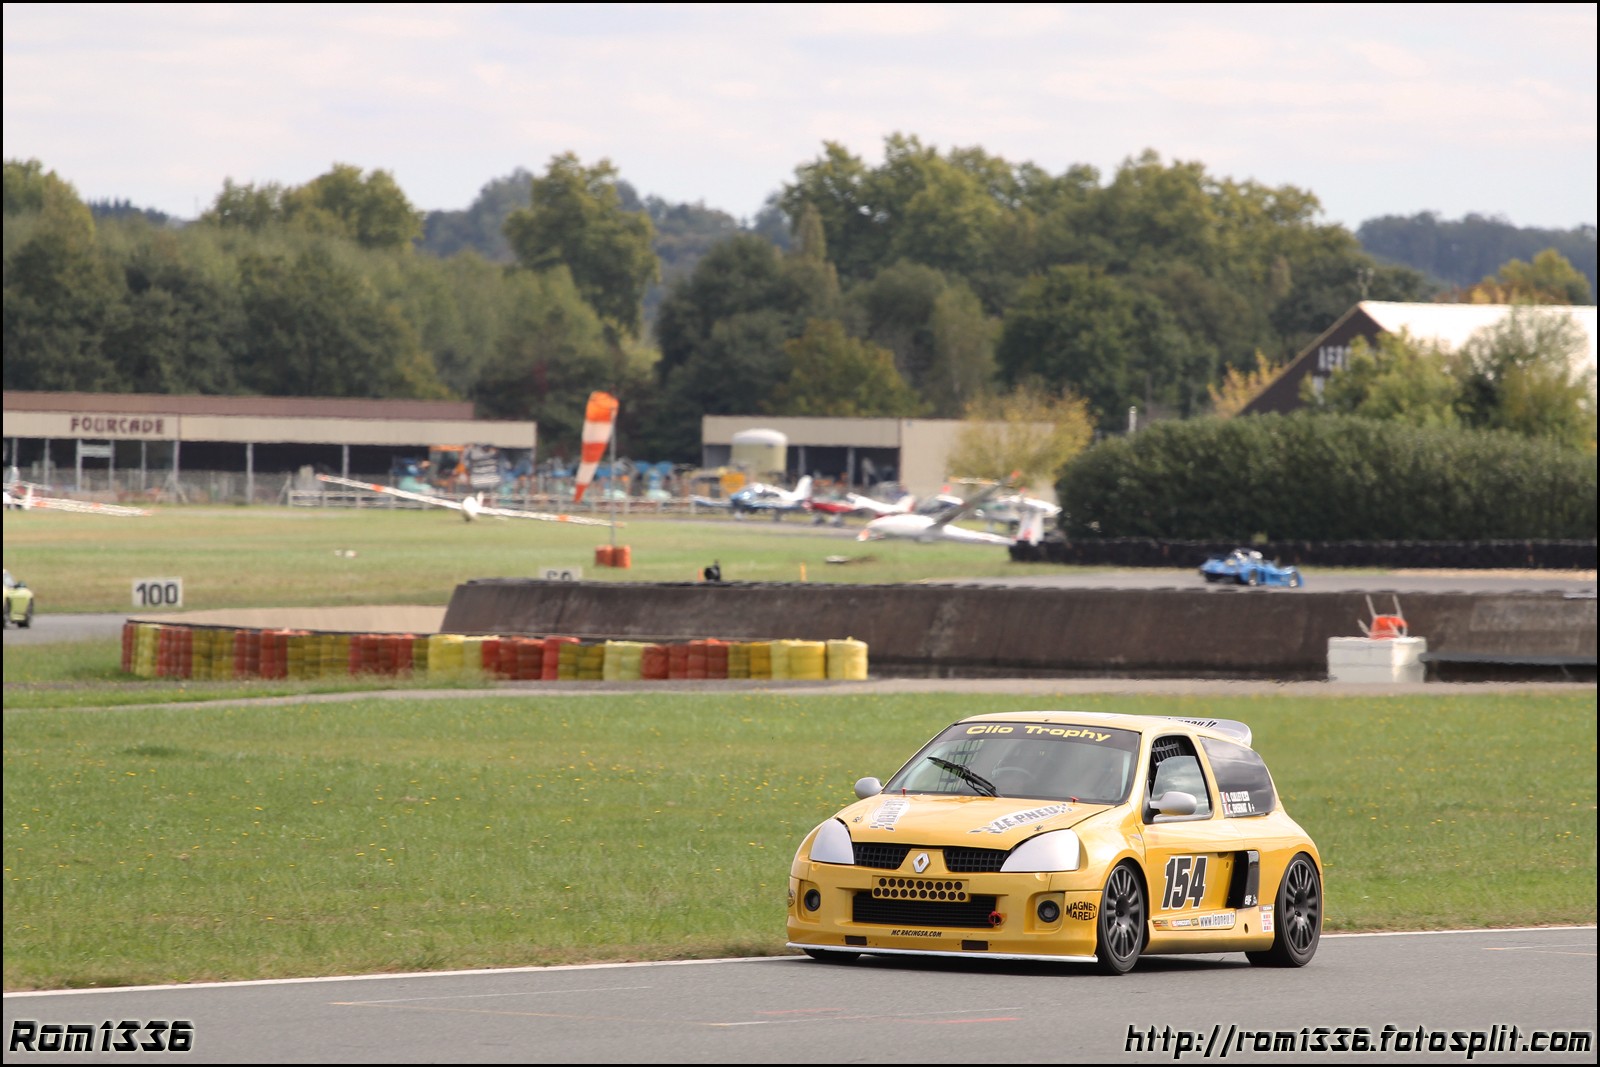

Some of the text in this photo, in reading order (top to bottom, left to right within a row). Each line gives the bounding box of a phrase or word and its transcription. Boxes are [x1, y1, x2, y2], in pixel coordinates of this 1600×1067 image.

[71, 417, 164, 434] FOURCADE
[136, 583, 178, 606] 100
[966, 725, 1111, 742] Clio Trophy
[994, 805, 1059, 832] LE PNEU
[1162, 857, 1207, 909] 154
